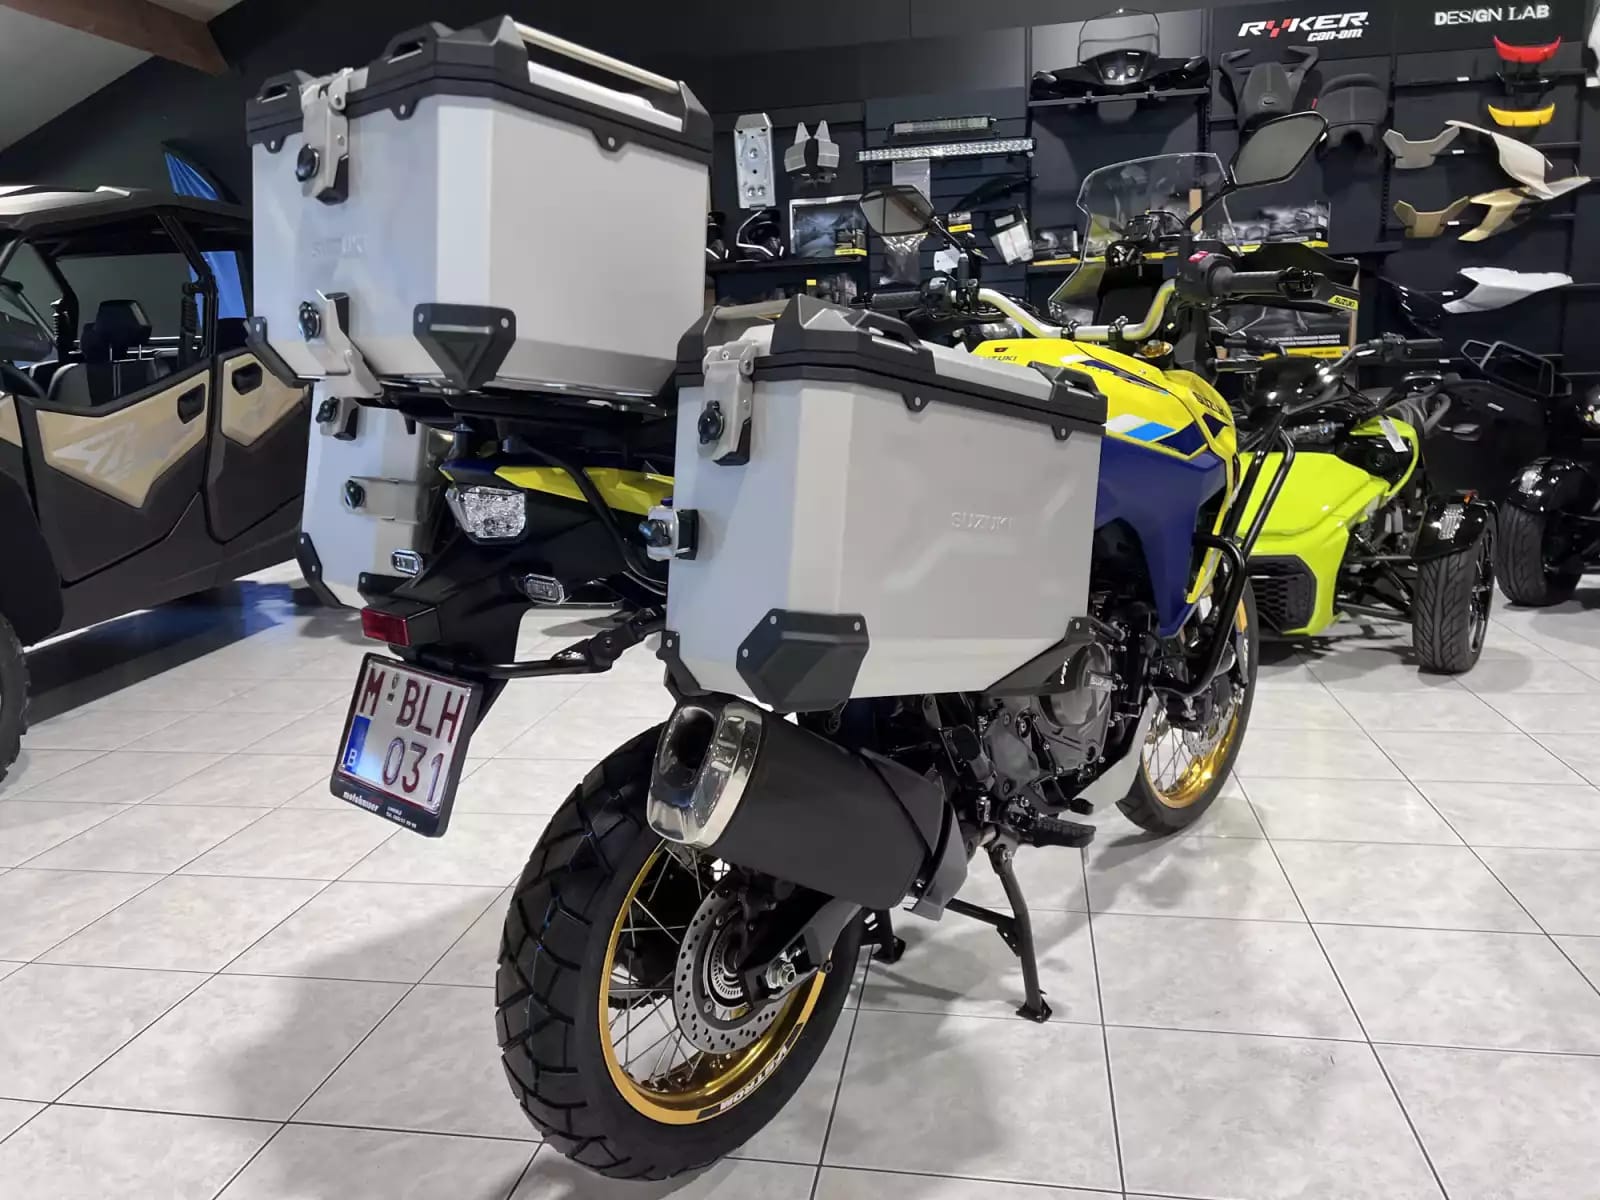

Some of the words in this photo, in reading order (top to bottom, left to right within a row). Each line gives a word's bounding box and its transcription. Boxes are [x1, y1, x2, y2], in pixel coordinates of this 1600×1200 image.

[1238, 11, 1368, 38] RYKER
[1434, 8, 1502, 26] DESIGN
[1508, 4, 1550, 20] LAB
[1307, 28, 1362, 42] can-am
[951, 511, 1015, 531] SUZUKI
[360, 667, 385, 716] M
[395, 678, 465, 743] BLH
[382, 736, 445, 802] 031
